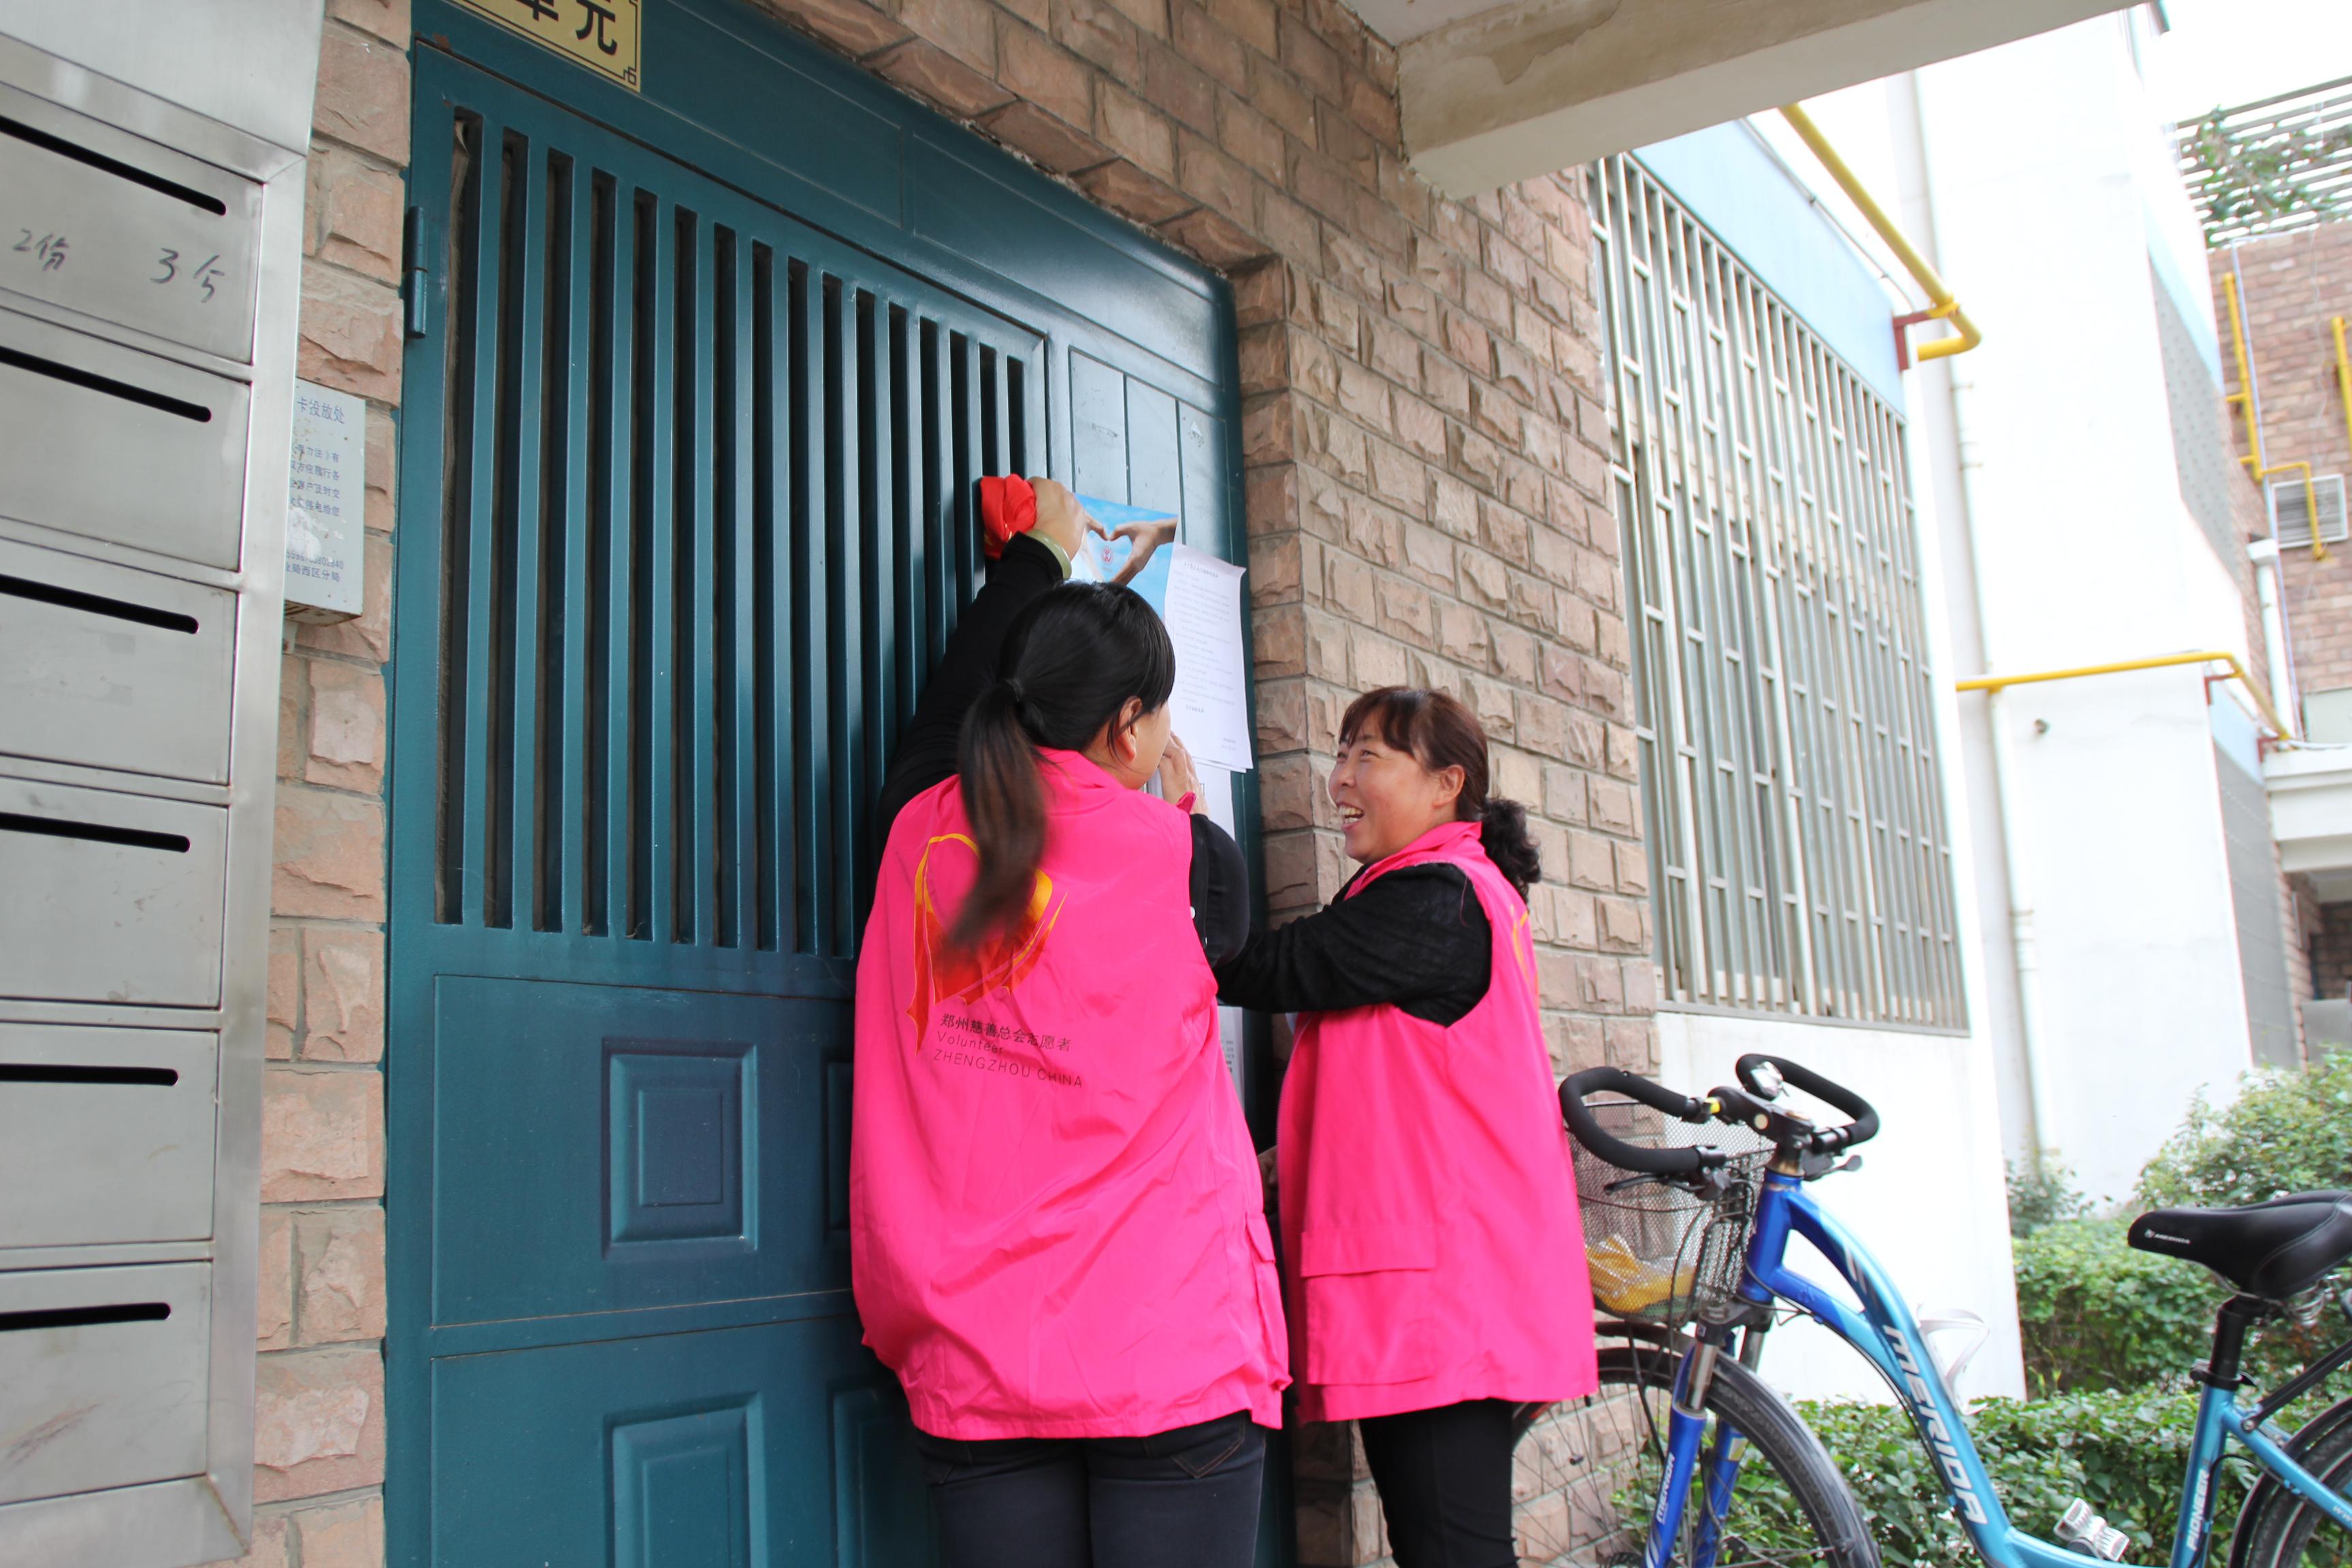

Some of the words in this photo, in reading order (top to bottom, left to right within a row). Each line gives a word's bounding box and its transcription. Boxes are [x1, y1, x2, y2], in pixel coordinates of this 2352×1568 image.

[297, 396, 345, 425] 卡投放处
[937, 1031, 1004, 1055] Volunteer
[940, 1013, 1073, 1052] 郑州慈善总会志愿者
[933, 1049, 1031, 1078] ZHENGZHOU
[1036, 1068, 1083, 1088] CHINA
